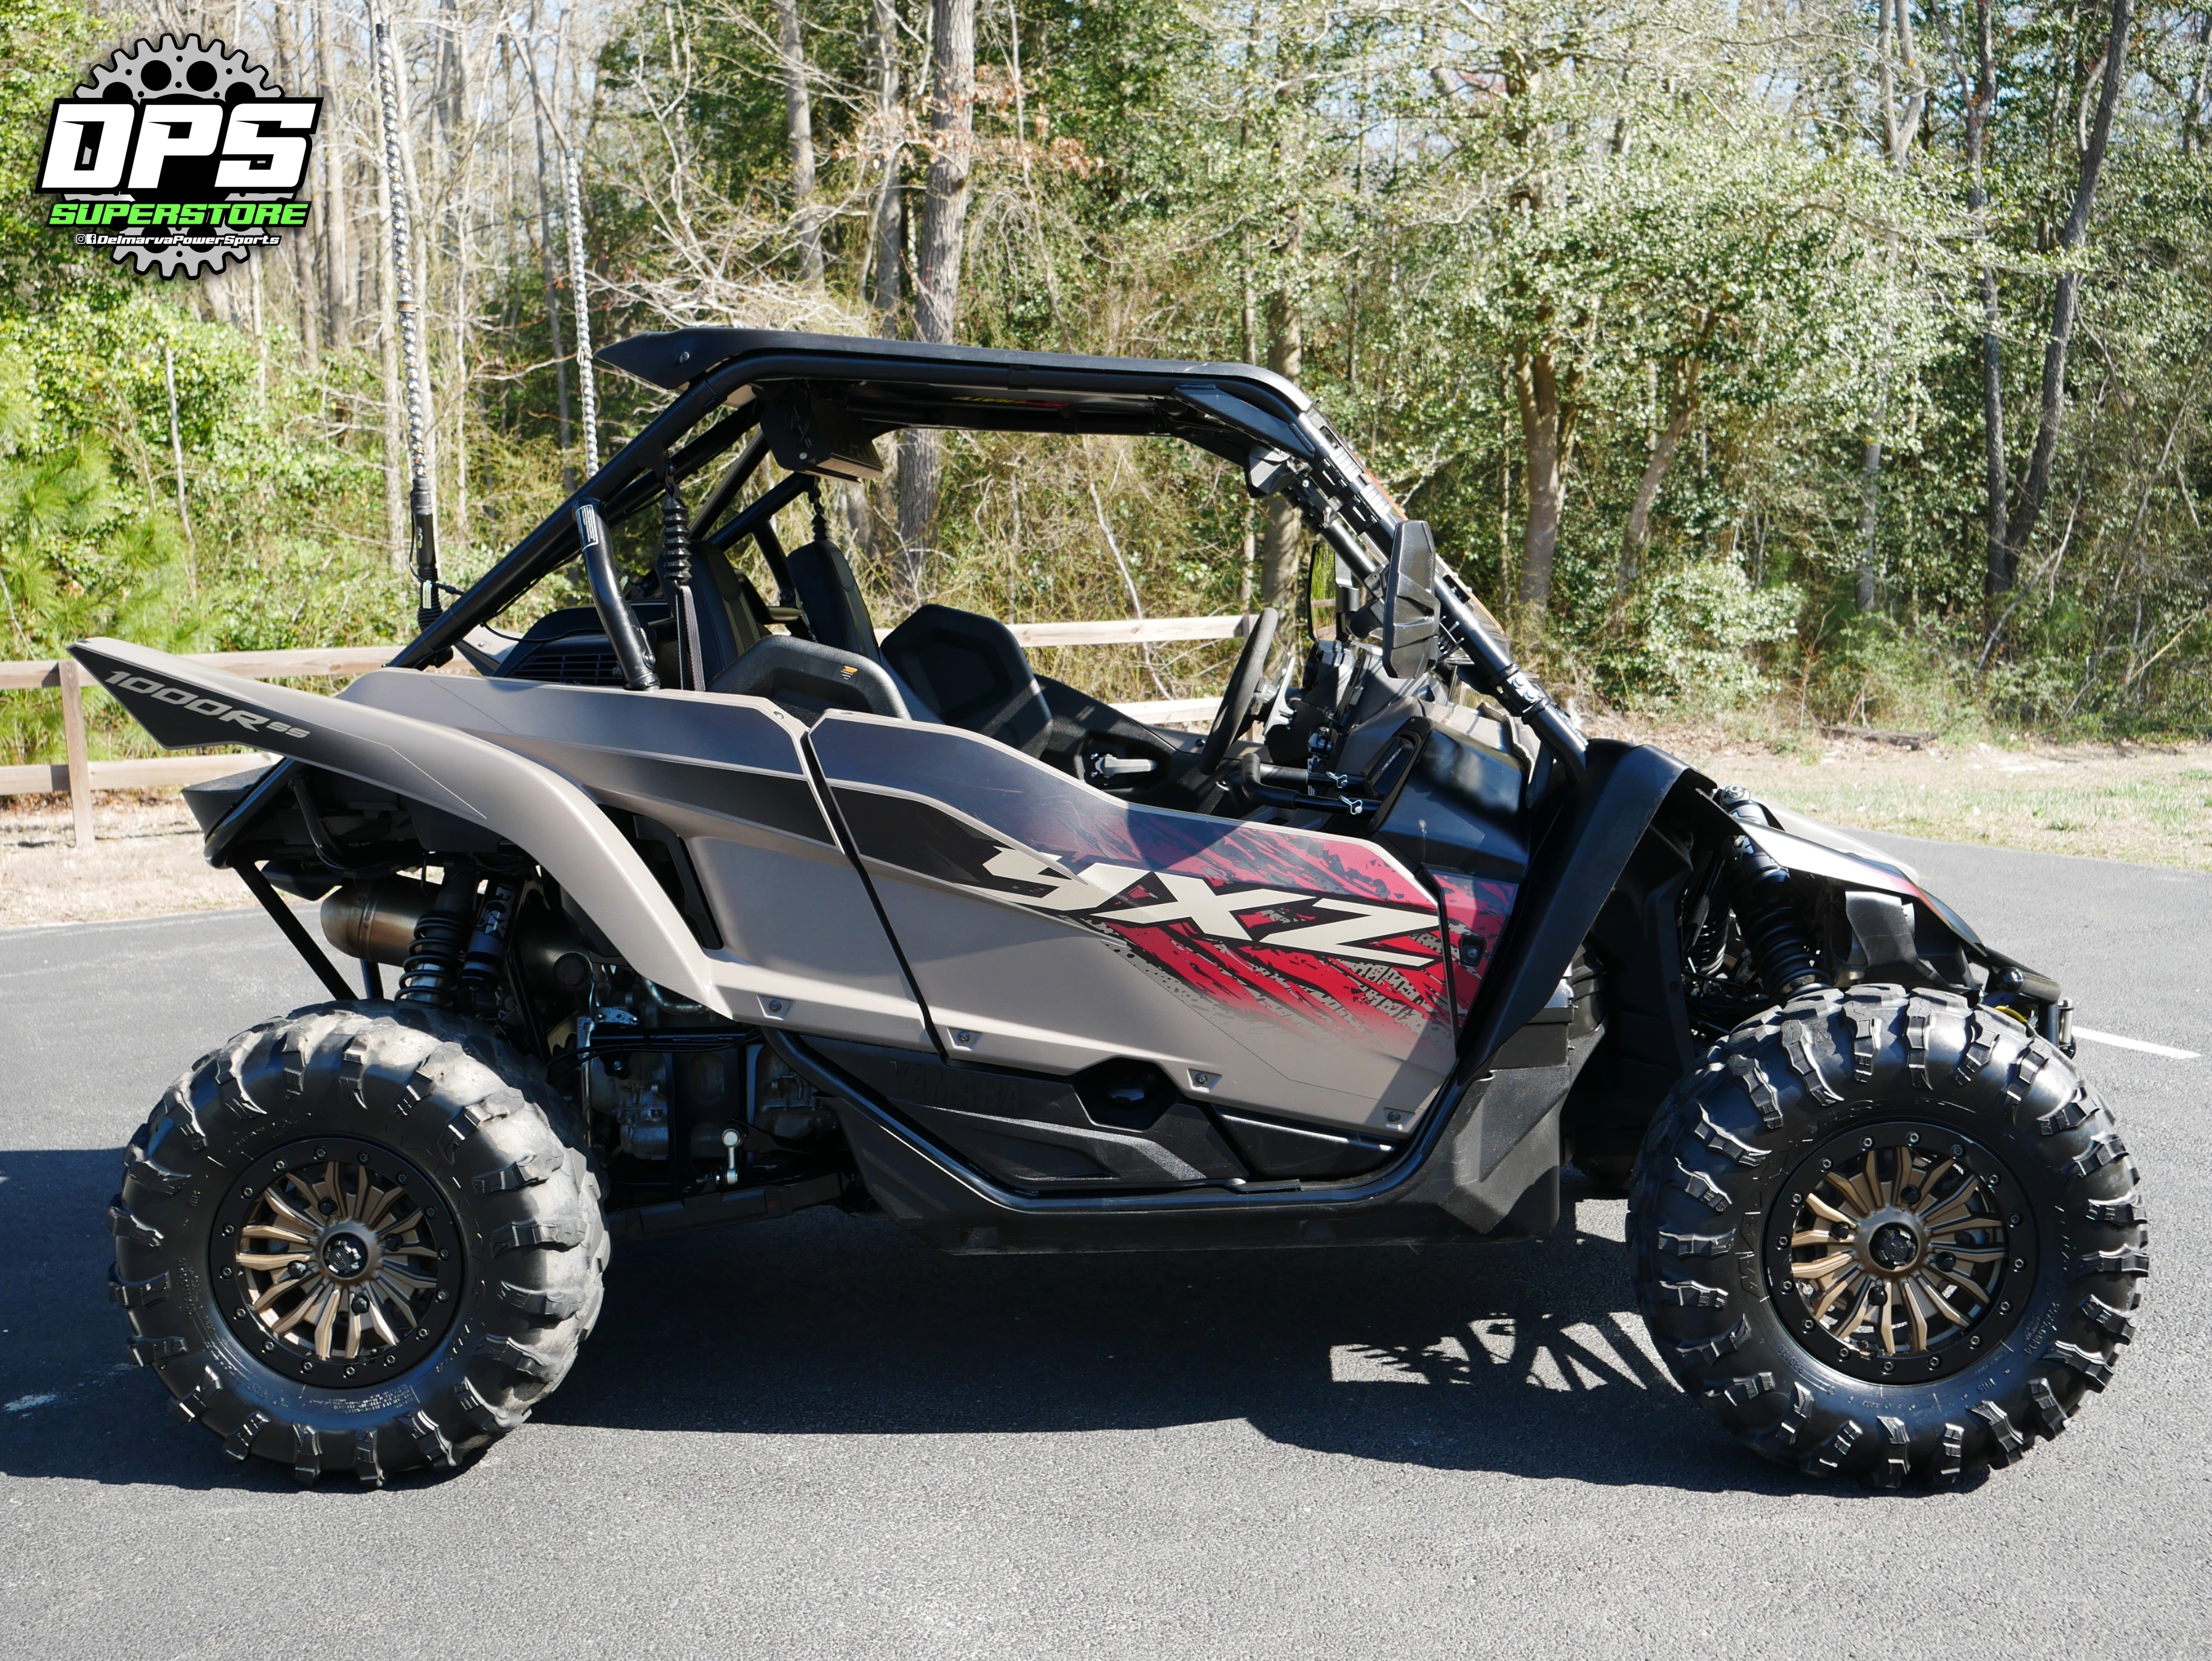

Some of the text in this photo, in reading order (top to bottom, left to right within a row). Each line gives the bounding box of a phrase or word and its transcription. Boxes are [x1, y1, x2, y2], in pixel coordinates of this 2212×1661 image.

[479, 886, 516, 939] FOX
[956, 845, 1439, 967] YXZ
[889, 1060, 1022, 1116] YAMAHA
